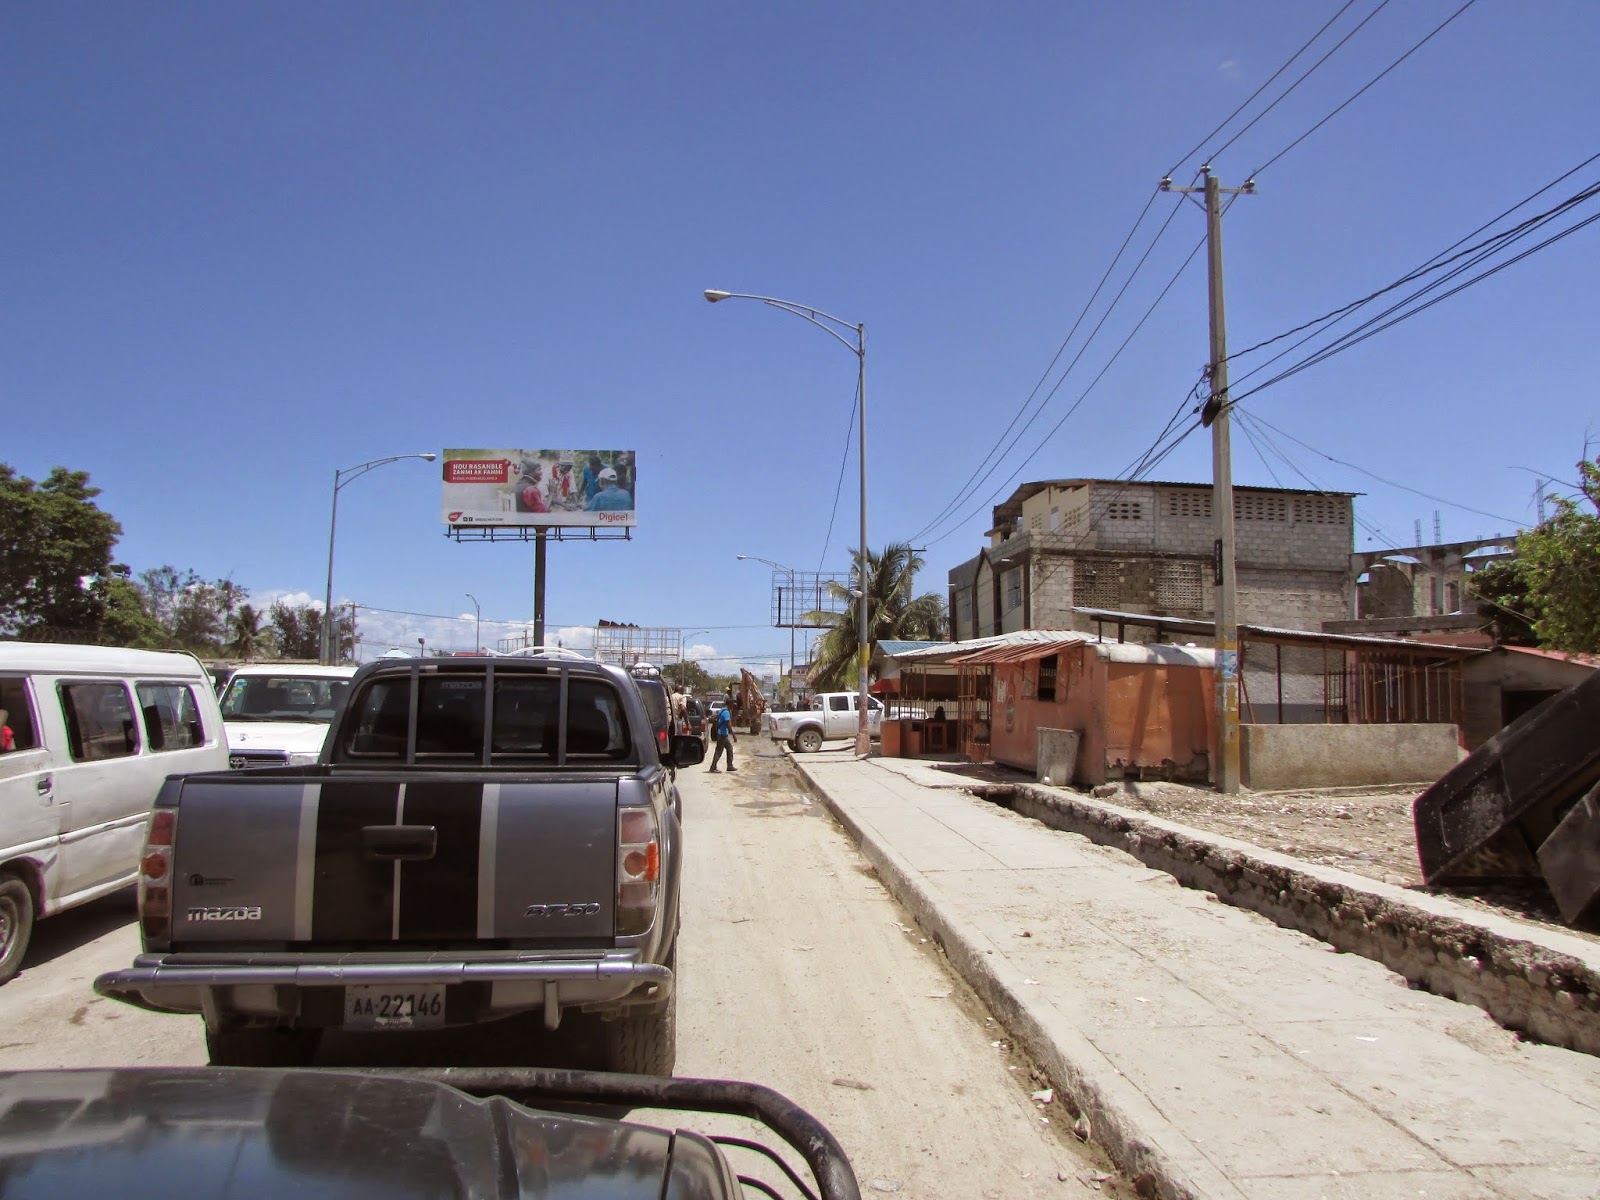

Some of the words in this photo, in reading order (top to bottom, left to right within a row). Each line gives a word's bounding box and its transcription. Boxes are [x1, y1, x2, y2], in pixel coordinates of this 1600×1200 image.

[599, 512, 628, 523] Digicel
[187, 906, 262, 921] mazda
[523, 902, 601, 918] BT-50
